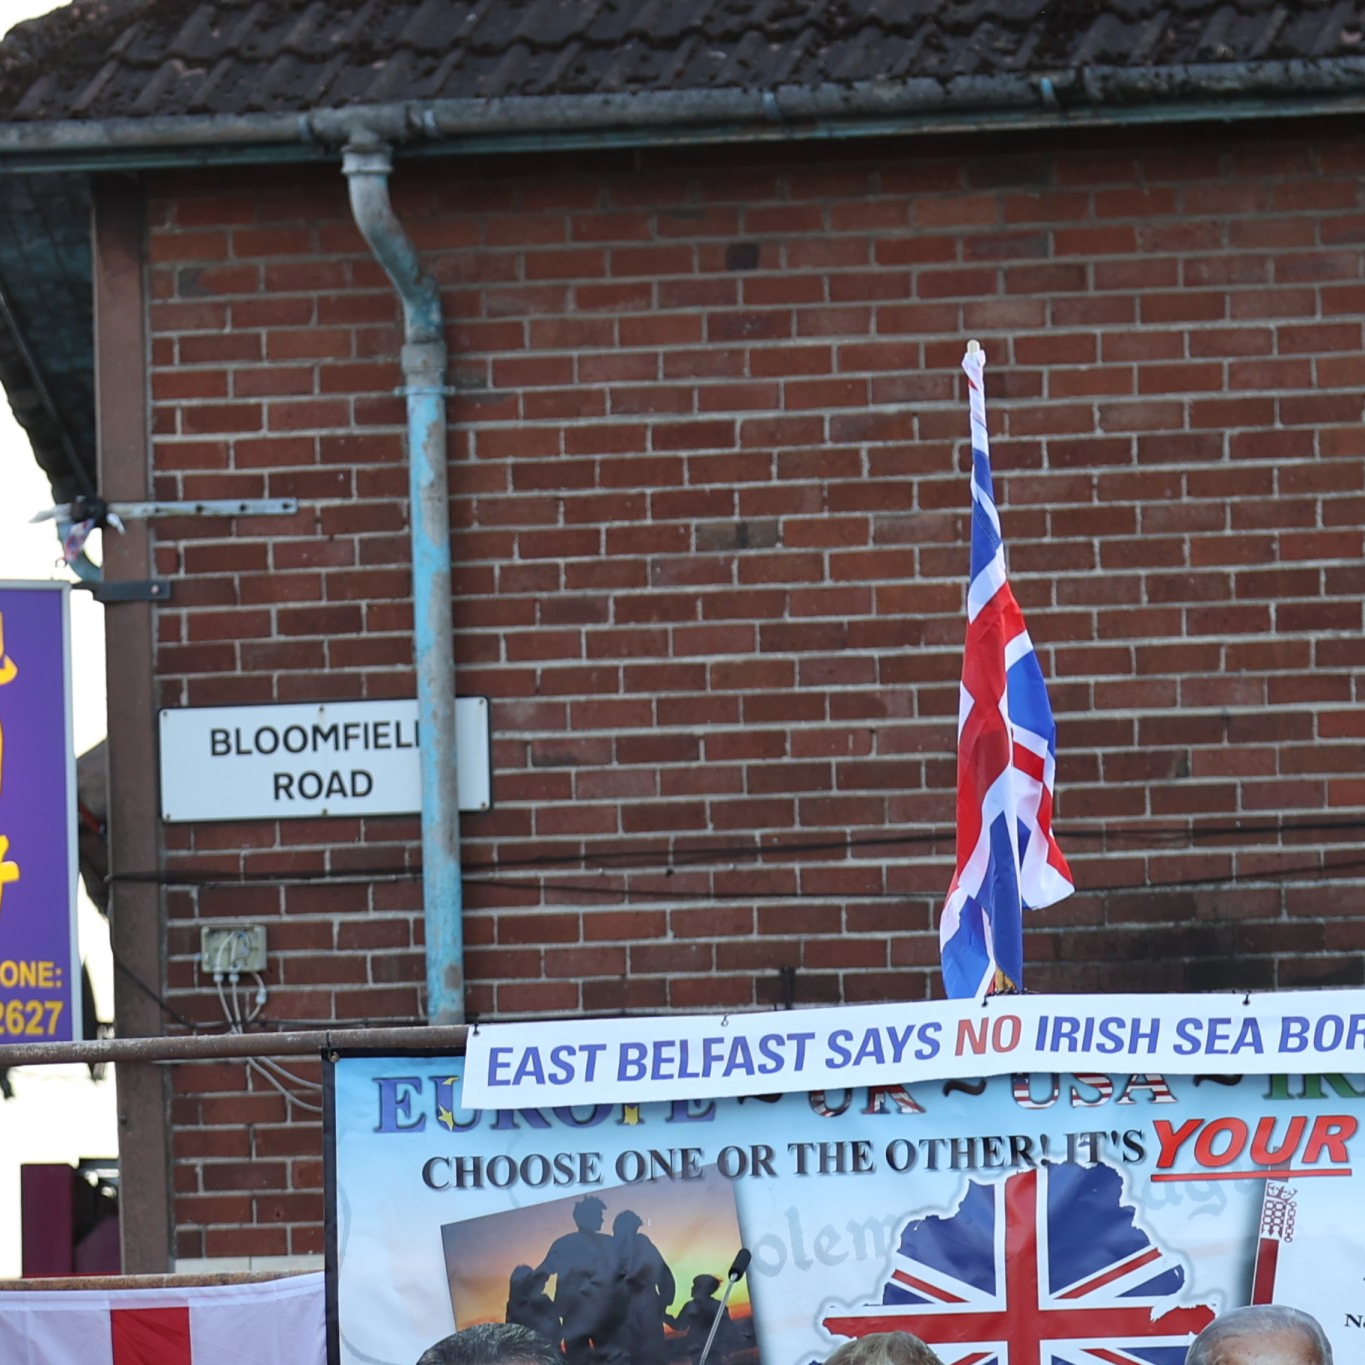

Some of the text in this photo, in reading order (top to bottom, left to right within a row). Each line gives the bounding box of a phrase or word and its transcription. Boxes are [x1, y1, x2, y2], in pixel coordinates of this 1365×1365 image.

[210, 720, 420, 756] BLOOMFIEL
[273, 769, 373, 801] ROAD
[486, 1043, 607, 1087] EAST
[617, 1031, 816, 1083] BELFAST
[825, 1021, 942, 1069] SAYS
[955, 1014, 1022, 1057] NO
[1035, 1013, 1160, 1056] IRISH
[1172, 1016, 1265, 1055] SEA
[1009, 1071, 1180, 1110] USA
[421, 1150, 603, 1191] CHOOSE
[615, 1146, 705, 1185] ONE
[716, 1143, 777, 1180] OR
[787, 1137, 875, 1178] THE
[884, 1130, 1049, 1174] OTHER!
[1063, 1128, 1146, 1167] IT'S
[1151, 1113, 1359, 1171] YOUR
